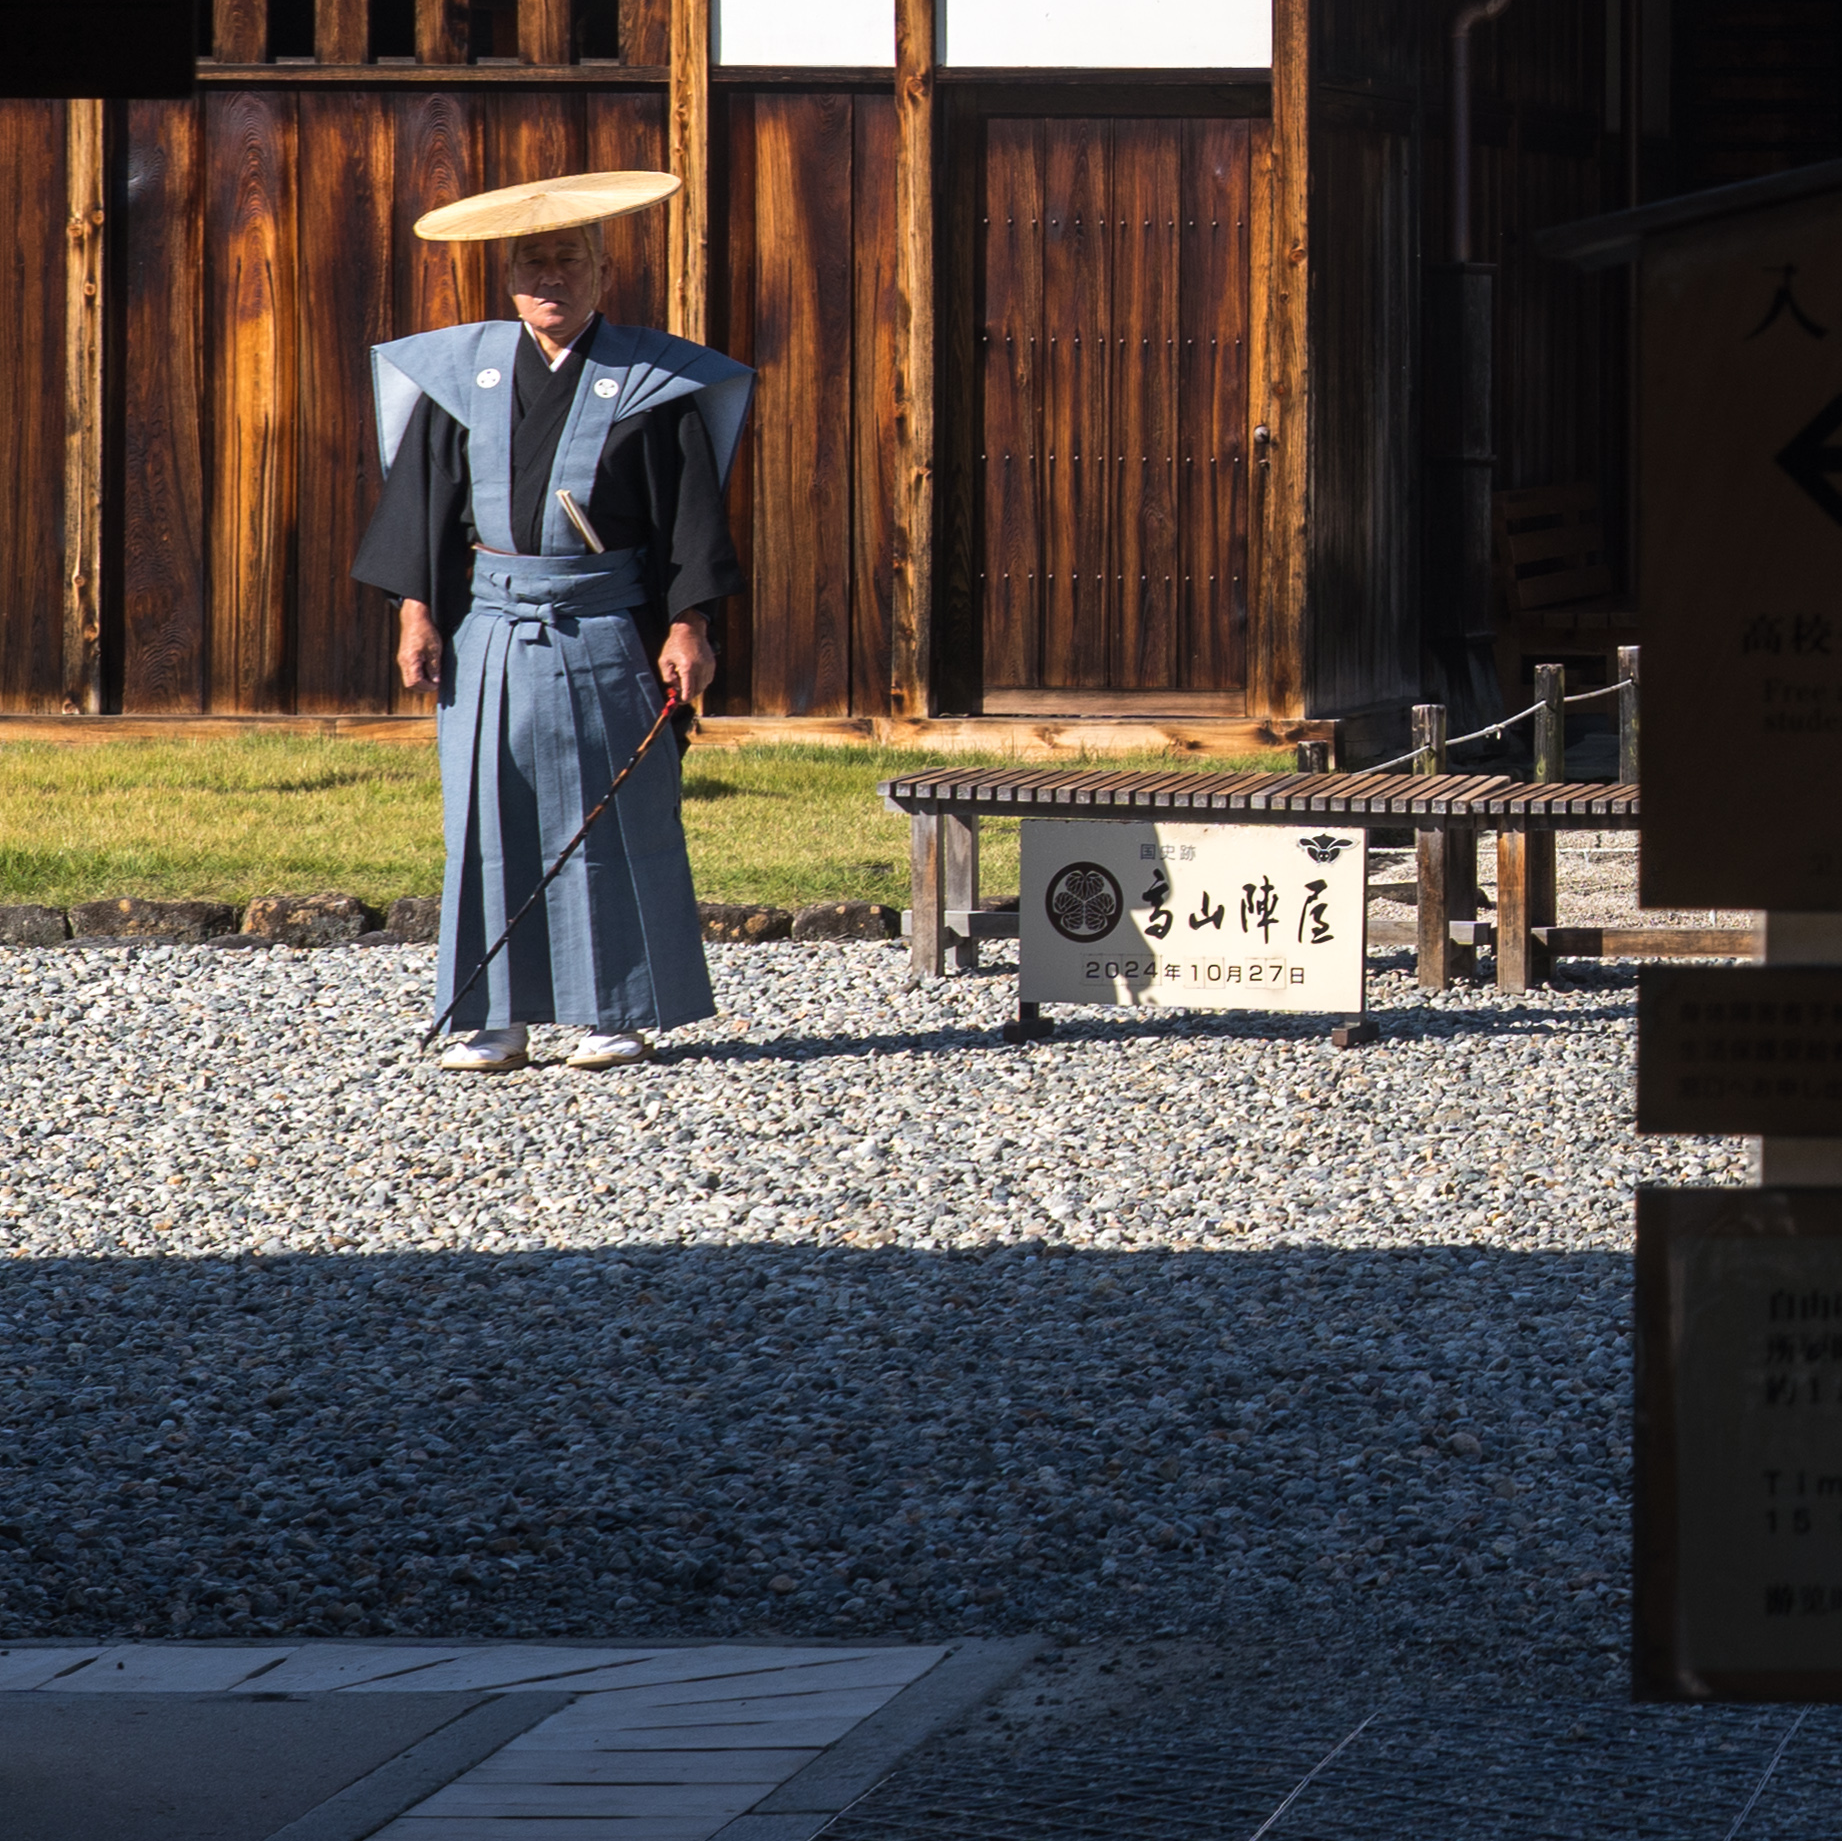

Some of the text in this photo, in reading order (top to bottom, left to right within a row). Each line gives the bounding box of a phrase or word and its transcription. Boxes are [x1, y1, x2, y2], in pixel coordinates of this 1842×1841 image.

[1762, 677, 1826, 705] Free
[1140, 843, 1196, 861] 国史跡
[1085, 961, 1305, 985] 2024年10月27日
[1764, 1505, 1814, 1536] 15
